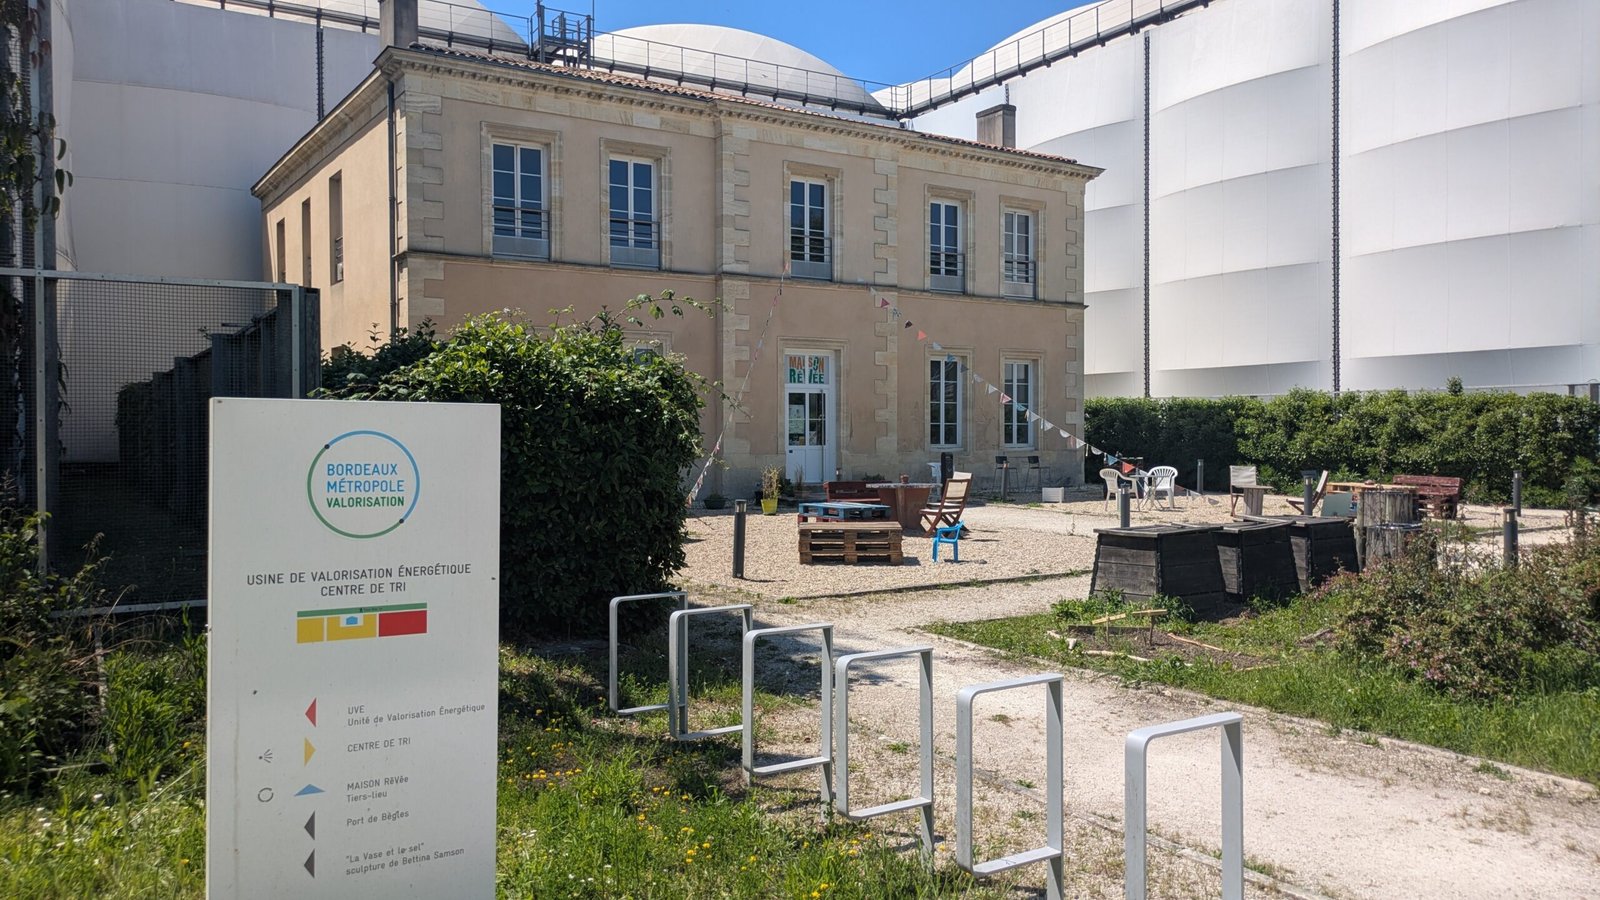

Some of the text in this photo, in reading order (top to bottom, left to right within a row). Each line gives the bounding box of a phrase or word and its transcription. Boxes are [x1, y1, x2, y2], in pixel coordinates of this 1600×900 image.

[789, 356, 824, 373] MAISON
[327, 464, 397, 476] BORDEAUX
[327, 478, 404, 493] MÉTROPOLE
[326, 496, 404, 508] VALORISATION
[247, 563, 471, 585] USINE DE VALORISATION ÉNERGÉTIQUE
[321, 582, 406, 596] CENTRE DE TRI
[348, 705, 365, 714] UVE
[348, 704, 485, 726] Unité de Valorisation Énergétique
[348, 741, 380, 752] CENTRE
[383, 739, 395, 747] DE
[347, 779, 380, 790] MAISON
[347, 790, 387, 802] Tiers-lieu
[347, 809, 409, 826] Port de Bègles
[364, 850, 384, 860] Vase
[386, 848, 395, 856] et
[346, 847, 465, 875] sculpture de Bettina Samson
